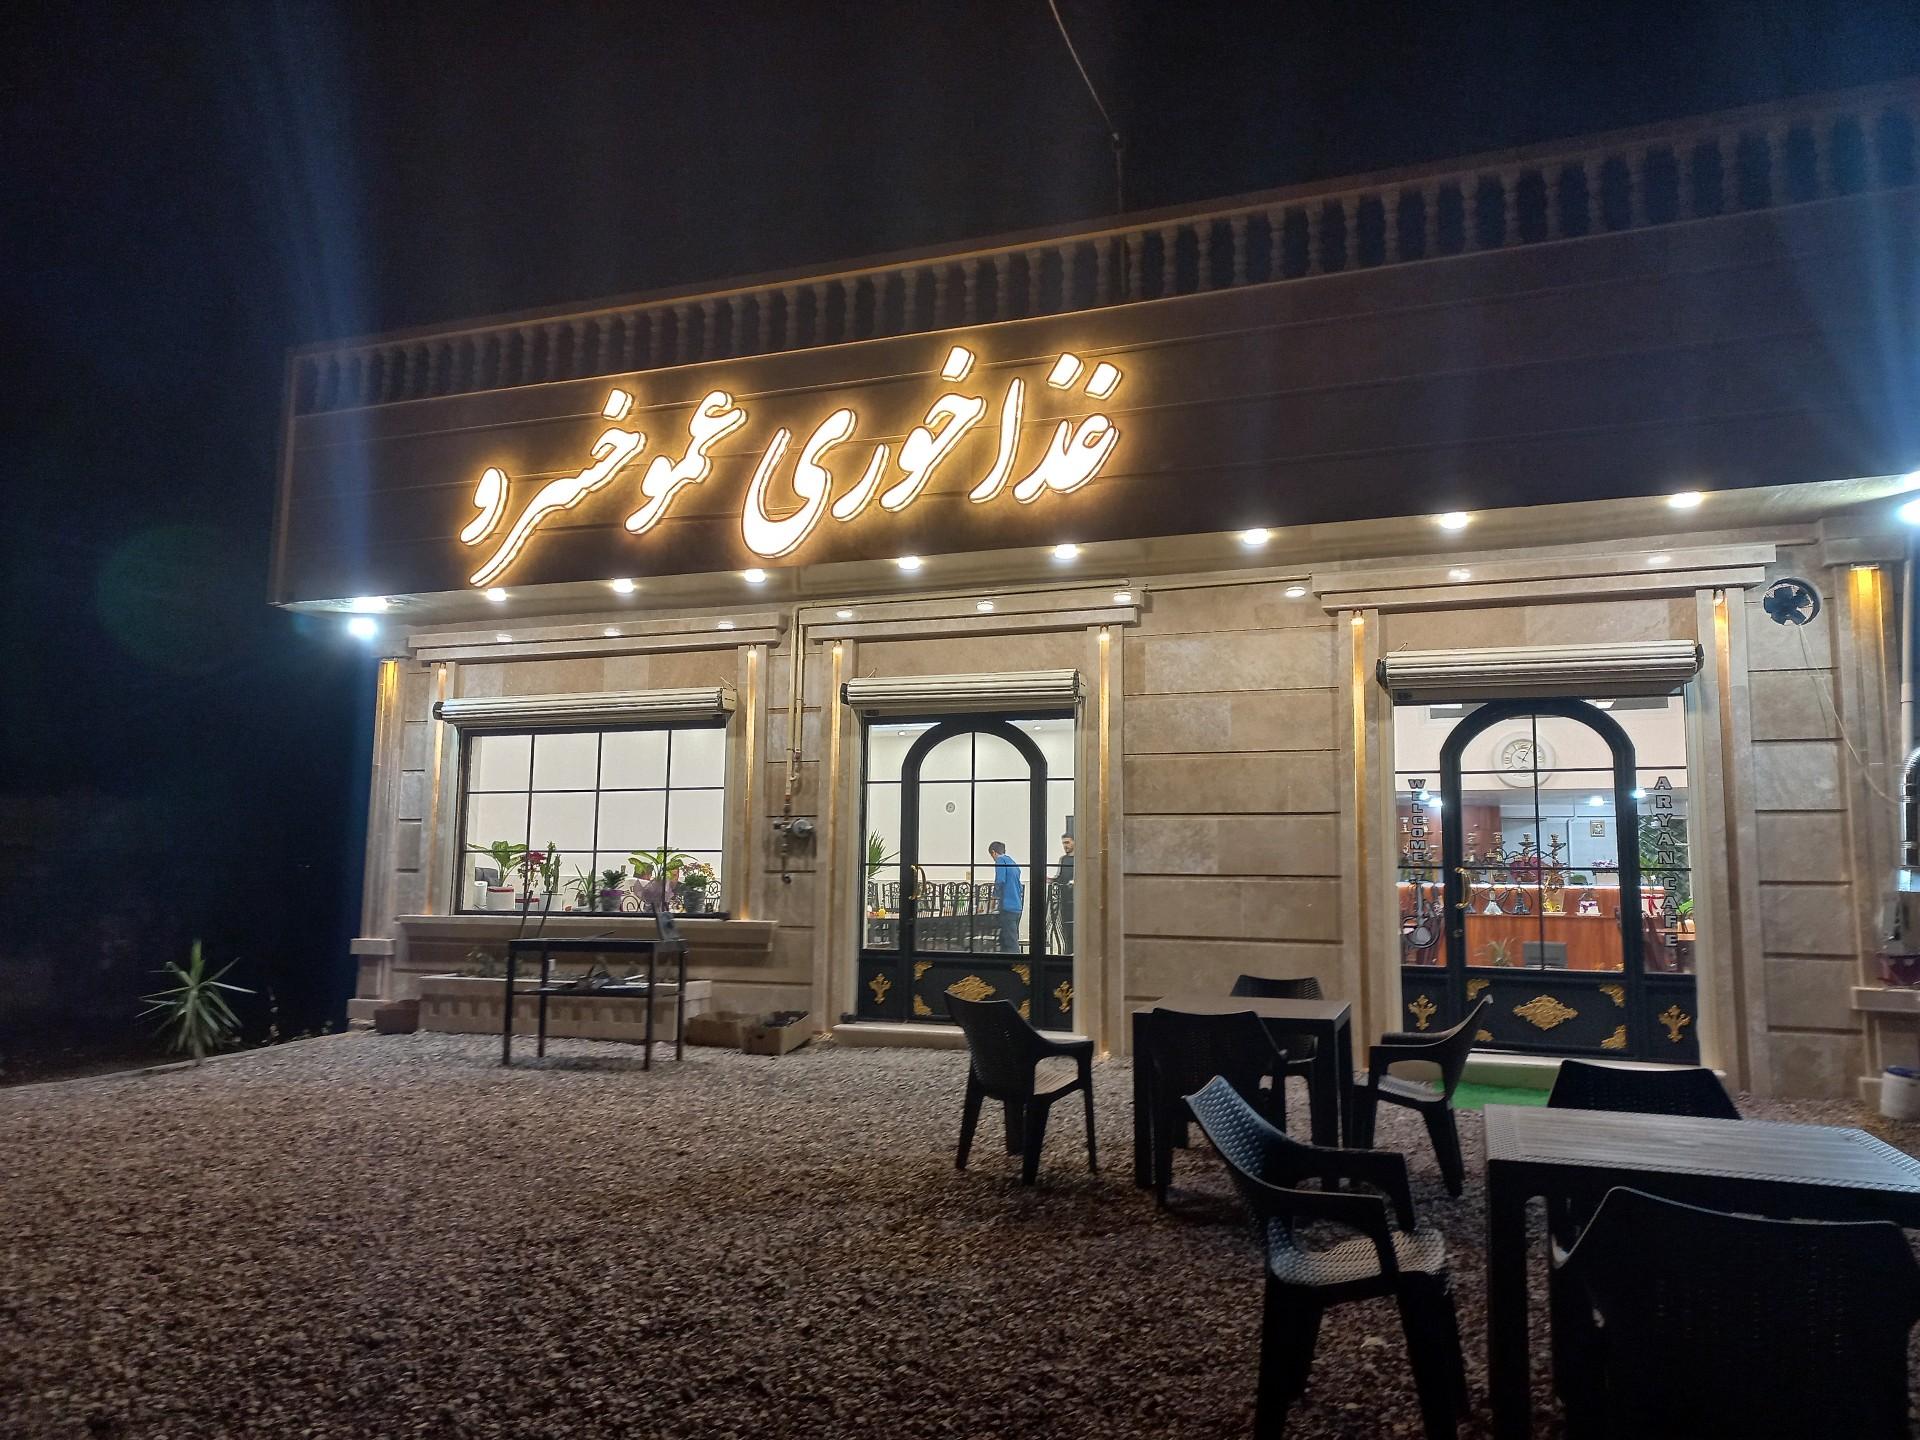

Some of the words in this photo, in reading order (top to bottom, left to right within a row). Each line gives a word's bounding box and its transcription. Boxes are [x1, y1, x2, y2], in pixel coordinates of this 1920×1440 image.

[460, 388, 646, 587] خسرو
[625, 391, 747, 534] عمو
[1408, 779, 1426, 862] WELCOME
[1654, 776, 1675, 865] ARYAN
[1661, 877, 1679, 947] CAFE
